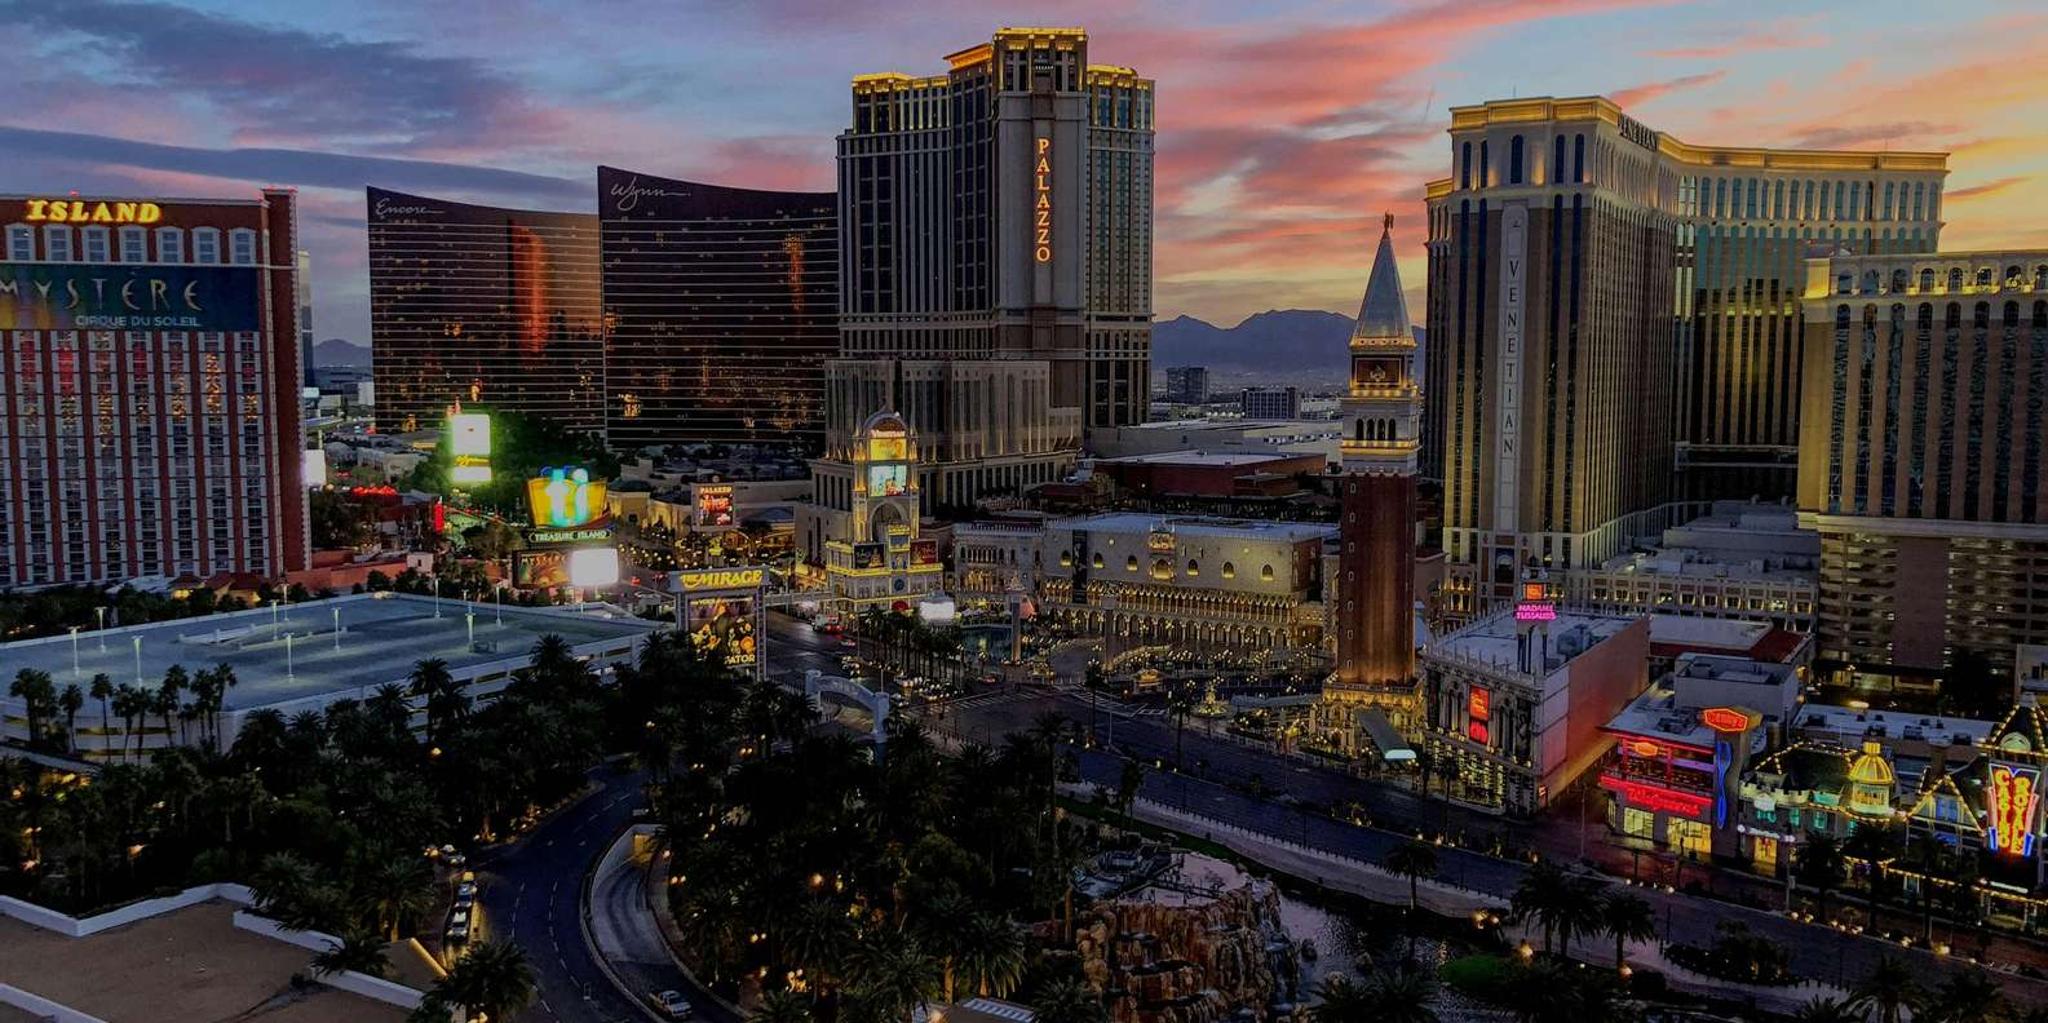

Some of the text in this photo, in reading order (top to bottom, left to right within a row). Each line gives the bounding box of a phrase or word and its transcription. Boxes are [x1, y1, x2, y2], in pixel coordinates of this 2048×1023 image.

[610, 176, 691, 212] Wynn
[1036, 138, 1050, 262] PALAZZO
[26, 199, 163, 223] ISLAND
[375, 198, 444, 217] Encore
[75, 315, 201, 329] CIRQUE DU SOLEIL
[1503, 259, 1519, 454] VENETIAN
[535, 530, 607, 541] TREASURE ISLAND
[701, 570, 762, 587] MIRAGE
[1995, 769, 2010, 848] CASINO
